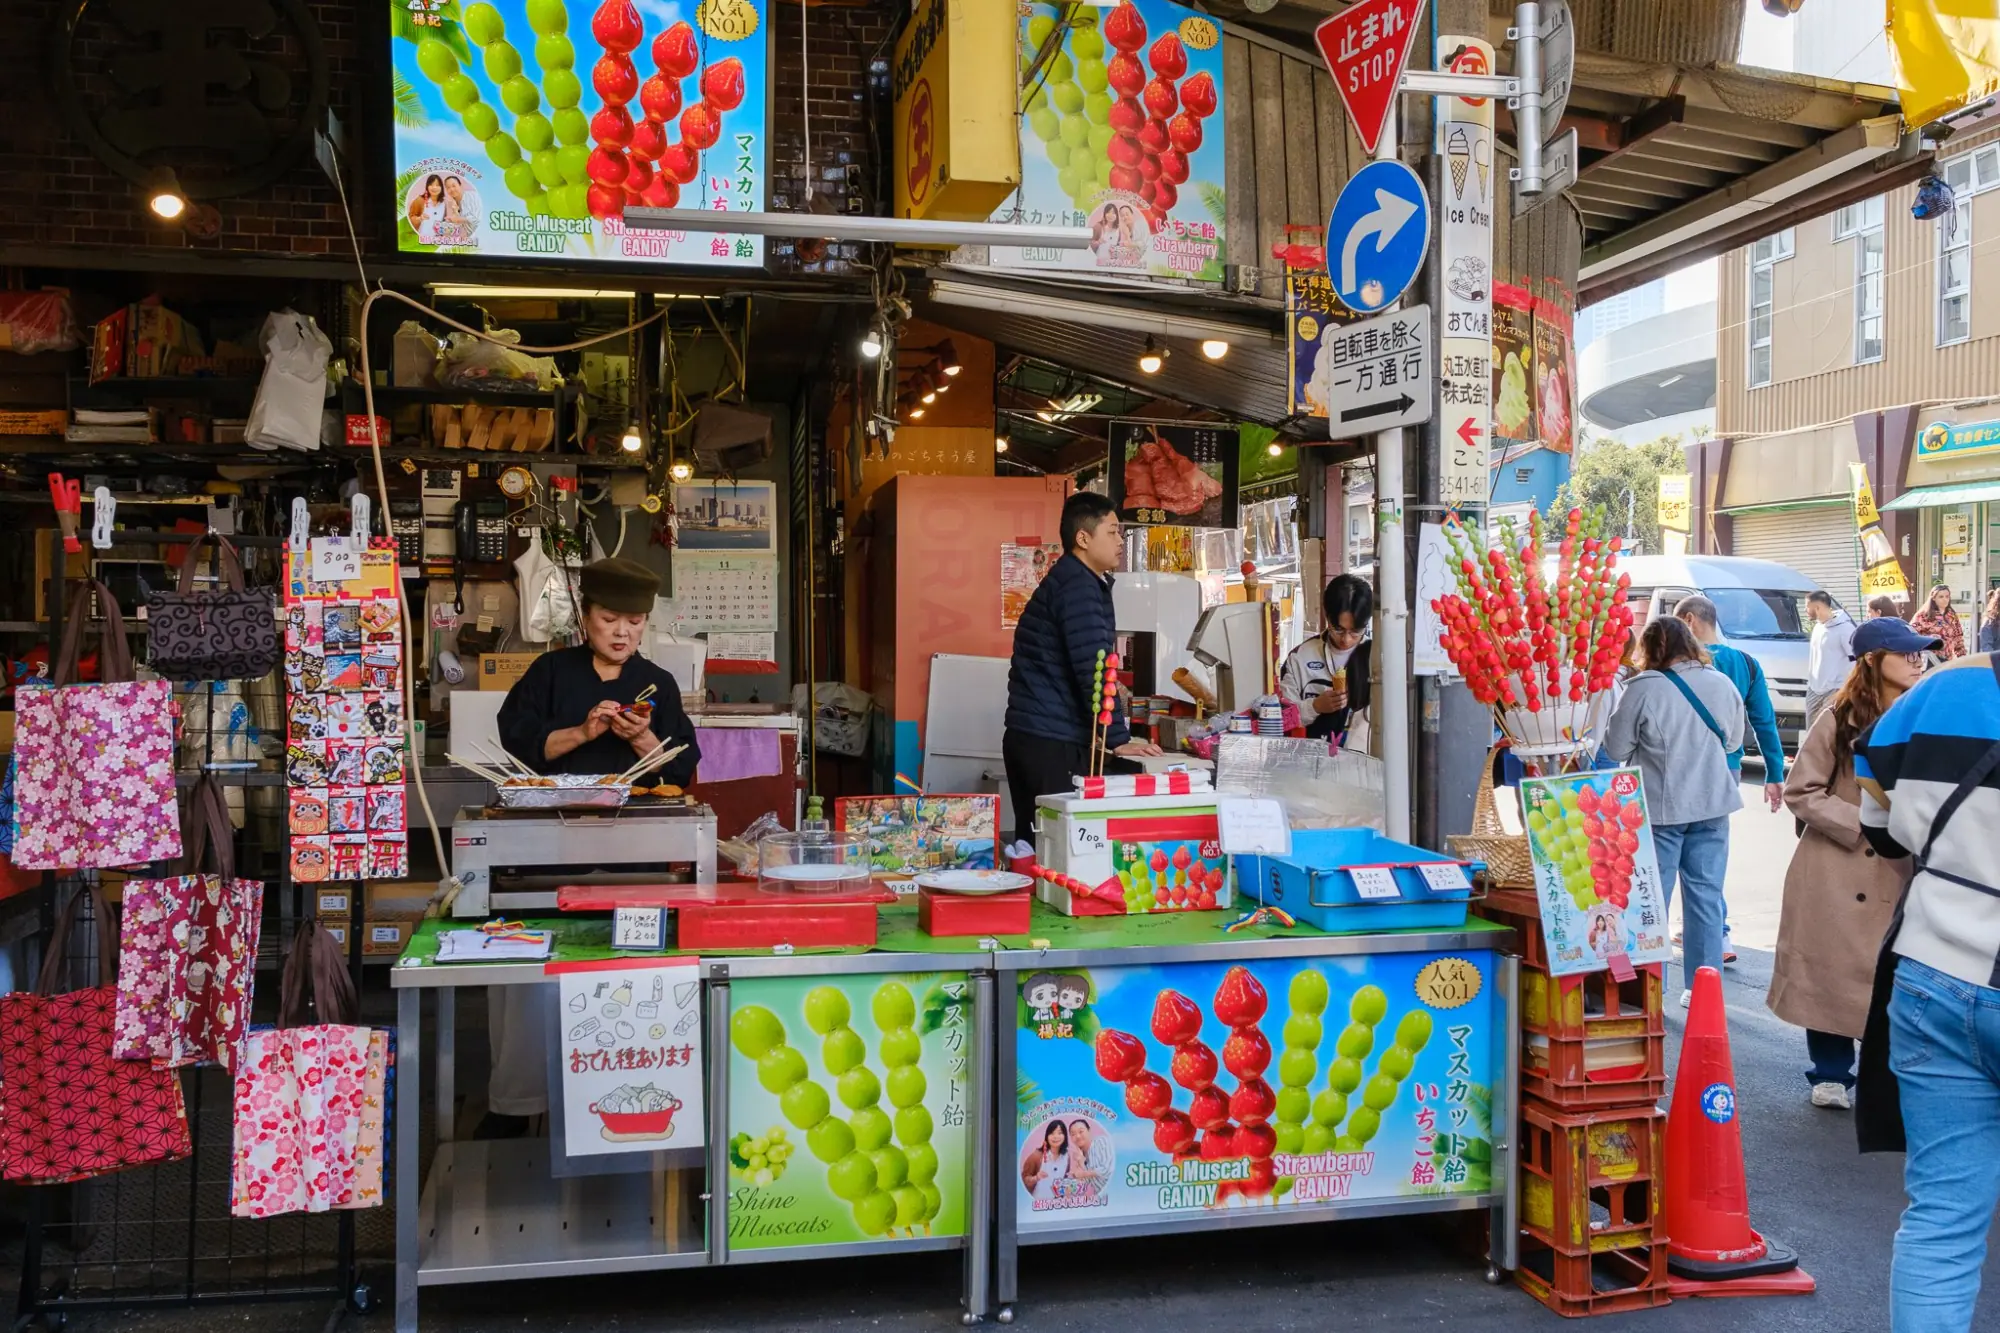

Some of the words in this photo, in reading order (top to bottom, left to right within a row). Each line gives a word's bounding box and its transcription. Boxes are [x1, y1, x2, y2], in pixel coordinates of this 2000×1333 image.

[710, 0, 744, 18] 人気
[710, 18, 750, 35] NO.1
[1337, 2, 1405, 64] 止まれ
[1187, 32, 1213, 47] NO.1
[1350, 48, 1395, 93] STOP
[733, 134, 754, 258] マスカッ飴
[490, 210, 534, 231] Shine
[536, 214, 592, 234] Muscat
[1446, 205, 1464, 223] Ice
[1156, 217, 1216, 240] いちご飴
[517, 232, 566, 253] CANDY
[622, 238, 670, 258] CANDY
[1153, 236, 1218, 260] Strawberry
[1168, 253, 1204, 271] CANDY
[1333, 320, 1423, 364] 自転車を除く
[1334, 352, 1422, 394] 一方通行
[1454, 450, 1484, 466] ここ
[323, 551, 349, 565] 800
[1872, 576, 1896, 588] 420
[1615, 782, 1635, 793] NO.1
[1078, 828, 1099, 842] 700
[1202, 848, 1220, 857] NO.1
[1543, 862, 1567, 942] マスカット飴
[1633, 866, 1655, 926] いちご飴
[1429, 963, 1466, 984] 人気
[1428, 981, 1470, 1002] NO.1
[1037, 1022, 1074, 1039] 楊記
[569, 1043, 696, 1074] おでん種あります
[940, 981, 967, 1128] マスカット飴
[1442, 1024, 1473, 1183] マスカット飴
[1411, 1082, 1439, 1186] いちご飴
[1126, 1161, 1180, 1187] Shine
[1182, 1156, 1250, 1182] Muscat
[1272, 1150, 1374, 1176] Strawberry
[1157, 1182, 1220, 1210] CANDY
[1293, 1172, 1352, 1199] CANDY
[730, 1187, 798, 1211] Shine
[729, 1213, 834, 1239] Muscats
